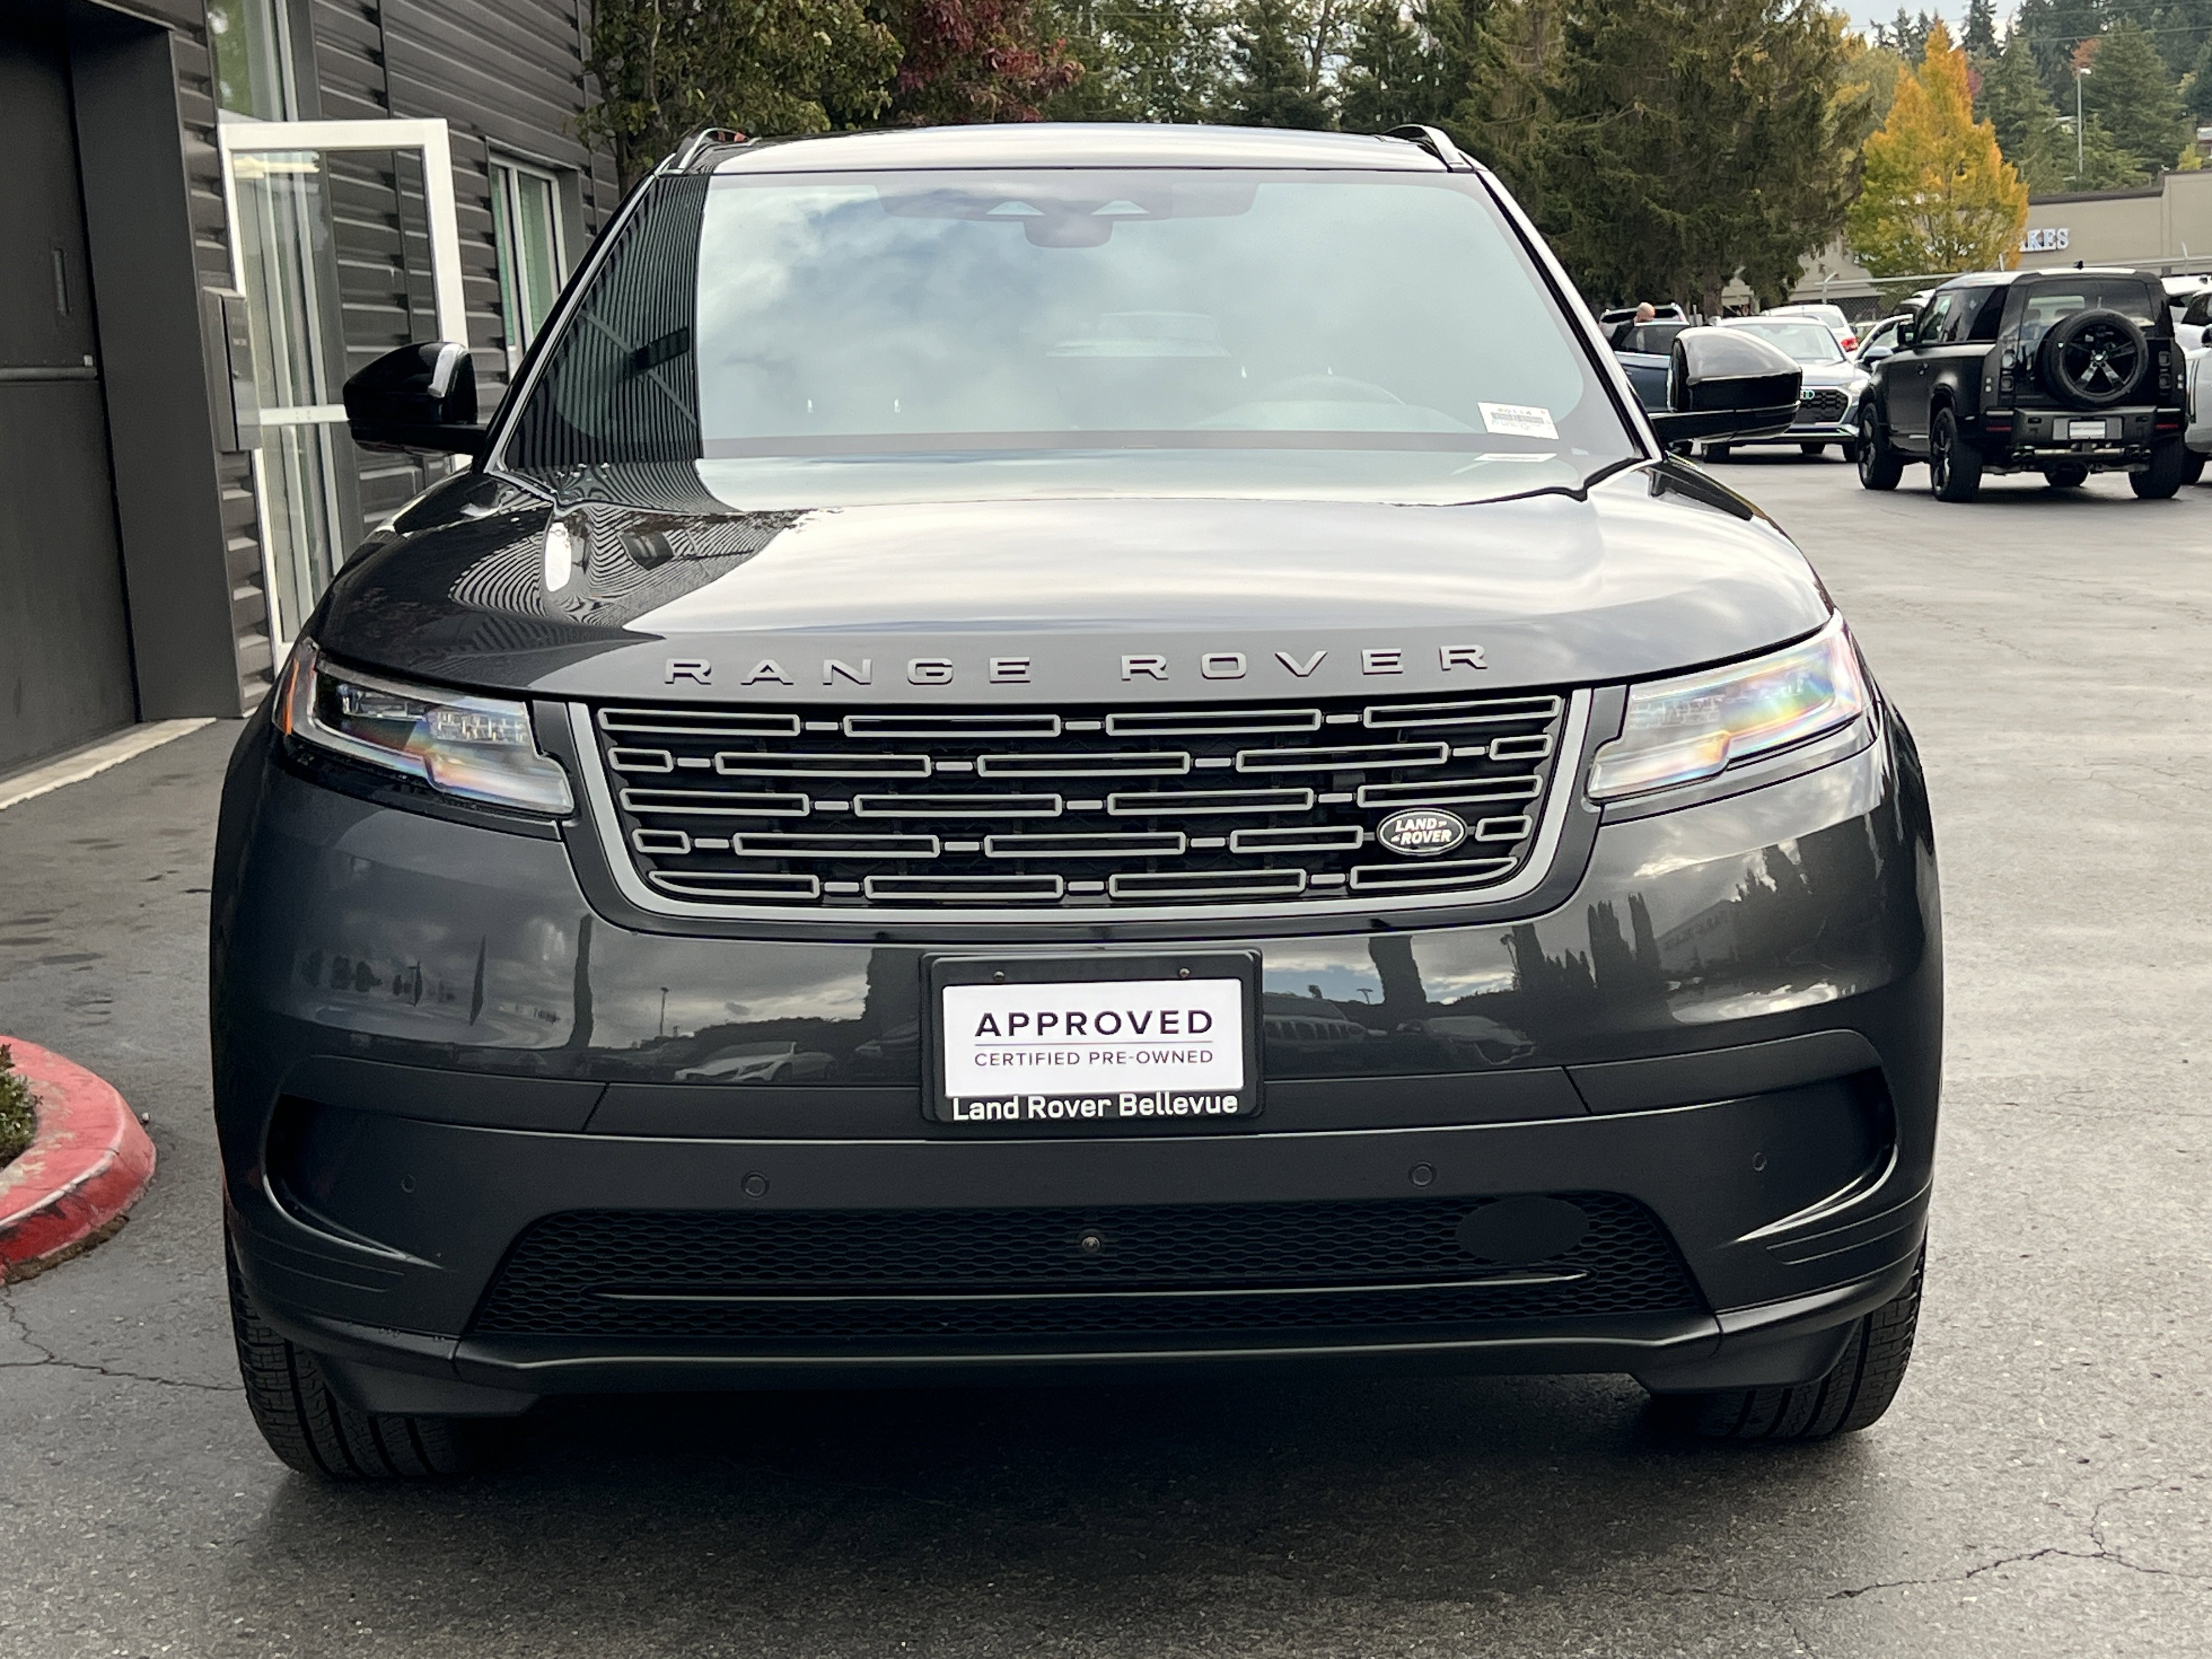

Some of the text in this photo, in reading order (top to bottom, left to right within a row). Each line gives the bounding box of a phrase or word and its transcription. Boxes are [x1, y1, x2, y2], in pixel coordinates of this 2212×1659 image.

[664, 644, 1488, 685] RANGE ROVER
[1395, 817, 1438, 832] LAND
[1400, 829, 1452, 845] ROVER
[974, 1010, 1213, 1036] APPROVED
[974, 1049, 1214, 1066] CERTIFIED PRE-OWNED
[952, 1091, 1238, 1121] Land Rover Bellevue
